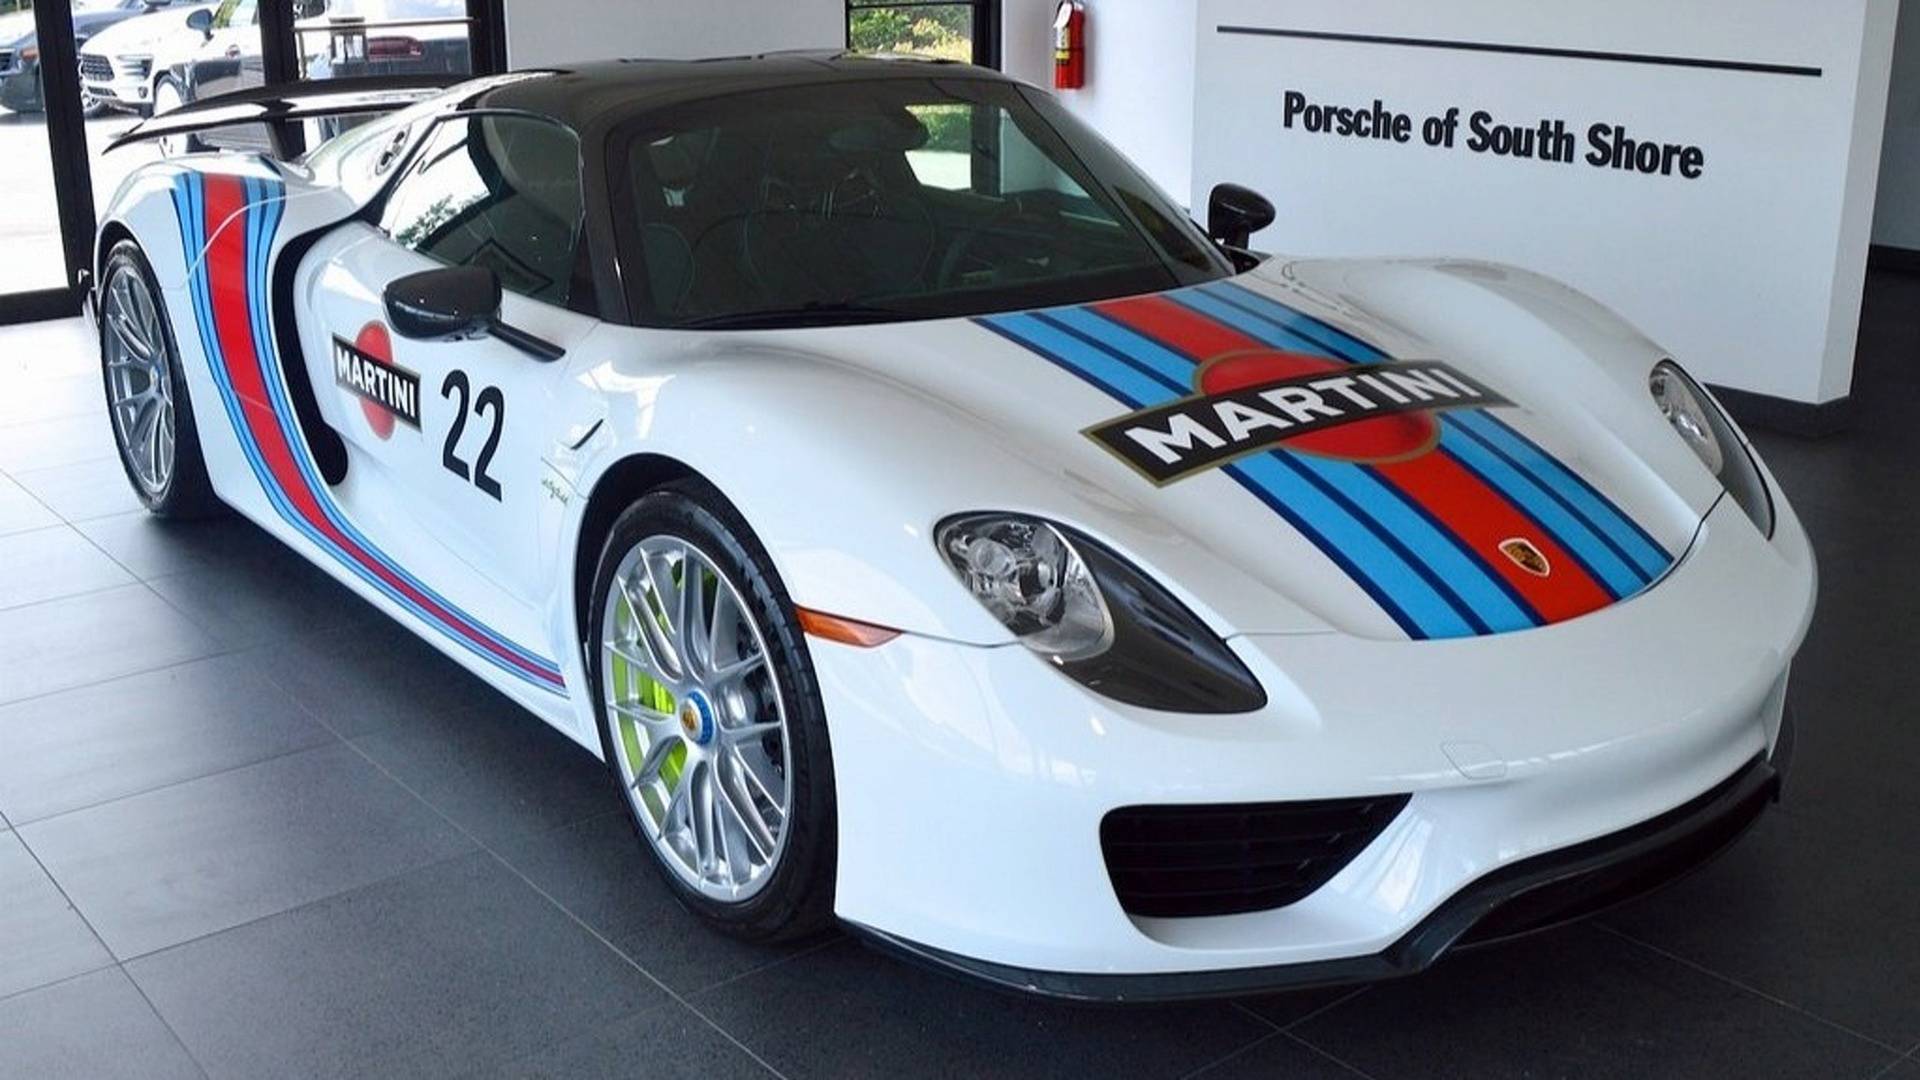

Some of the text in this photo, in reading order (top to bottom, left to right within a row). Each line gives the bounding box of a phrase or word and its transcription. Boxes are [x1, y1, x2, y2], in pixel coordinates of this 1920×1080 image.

[1283, 90, 1704, 179] Porsche of South Shore
[336, 347, 416, 417] MARTINI
[1124, 368, 1482, 464] MARTINI
[441, 369, 505, 502] 22
